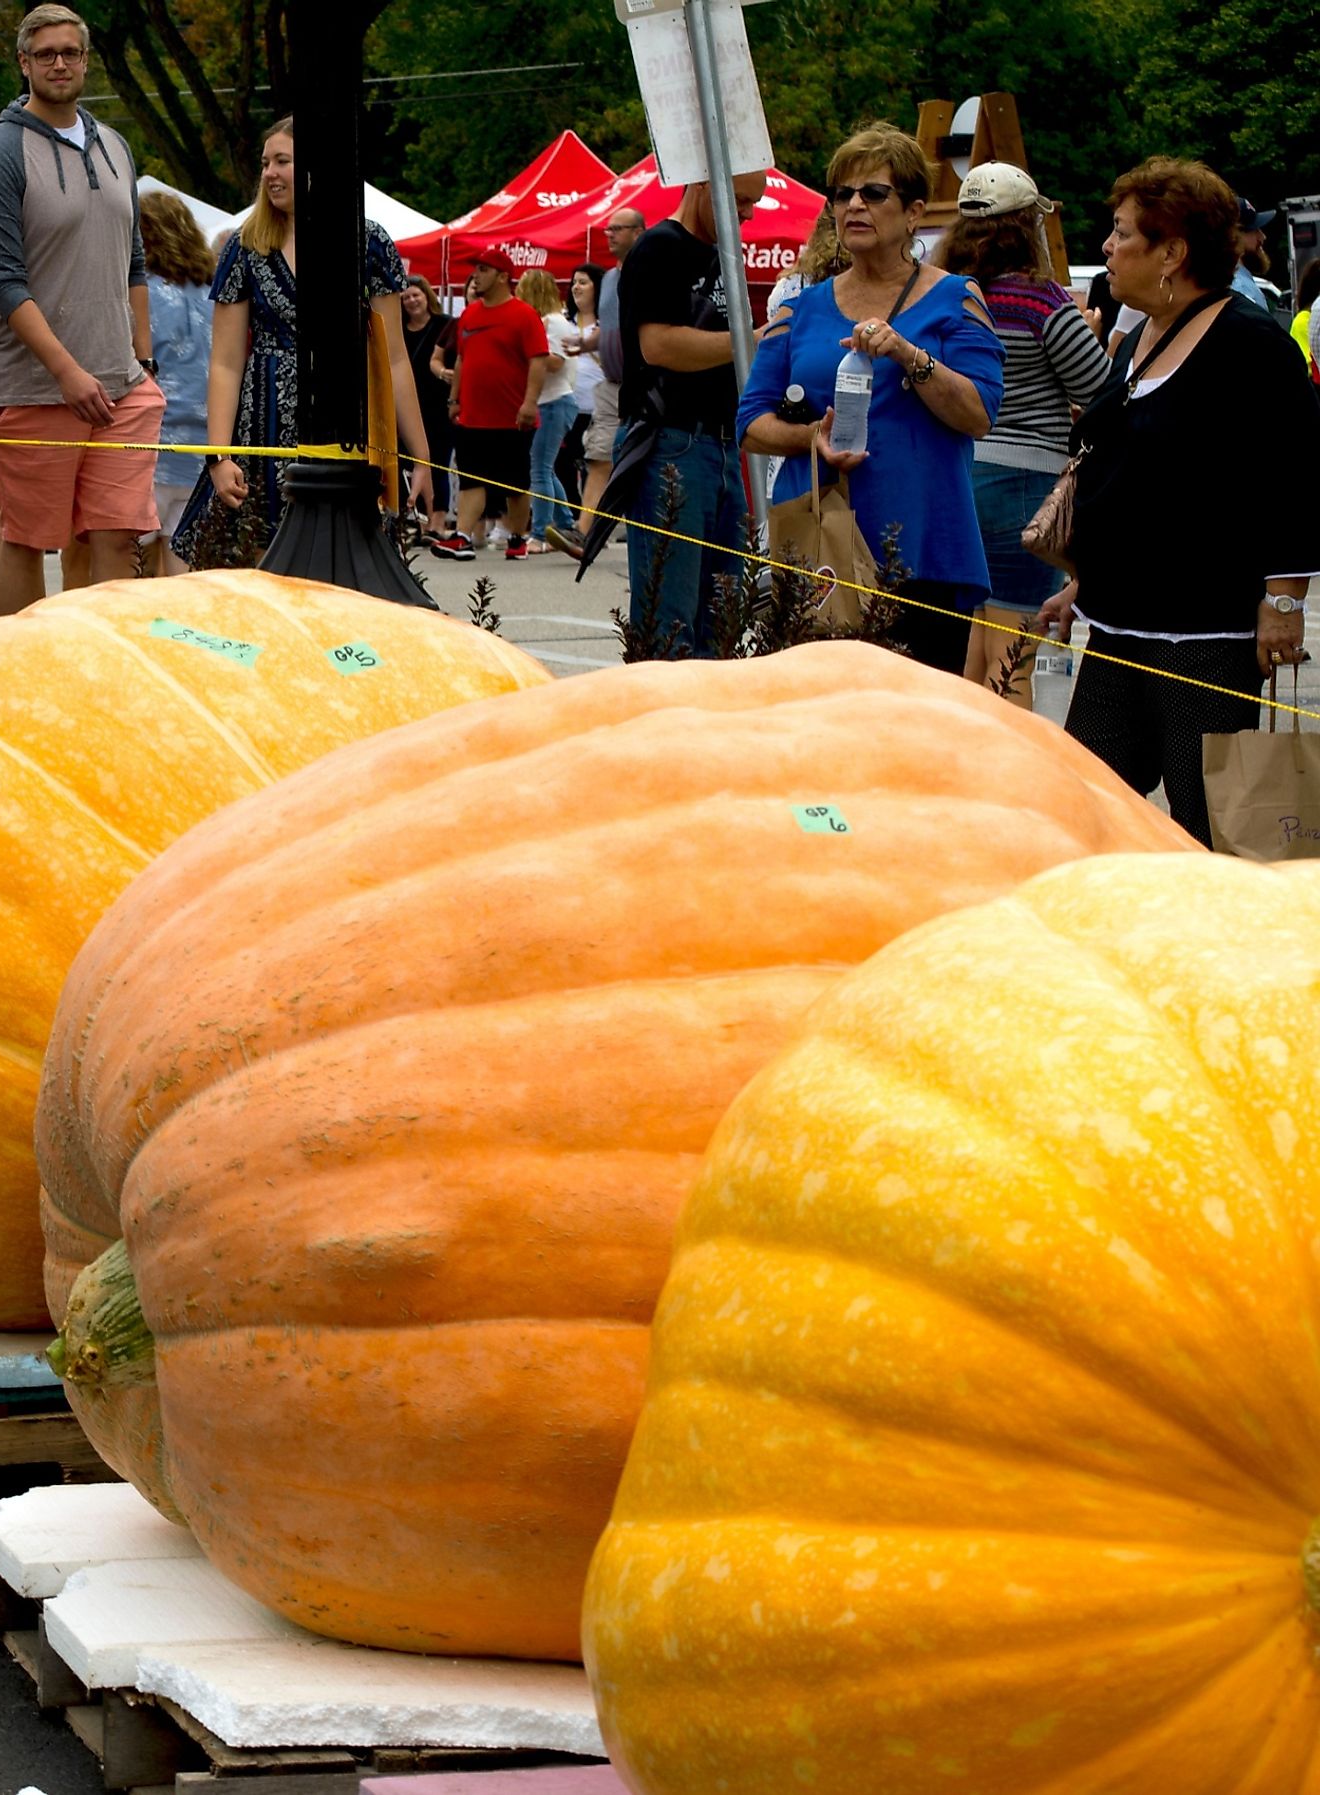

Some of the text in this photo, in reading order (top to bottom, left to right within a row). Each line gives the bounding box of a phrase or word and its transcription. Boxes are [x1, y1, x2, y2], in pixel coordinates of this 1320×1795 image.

[536, 190, 586, 207] Stat
[354, 651, 376, 667] 5
[829, 817, 847, 832] 6
